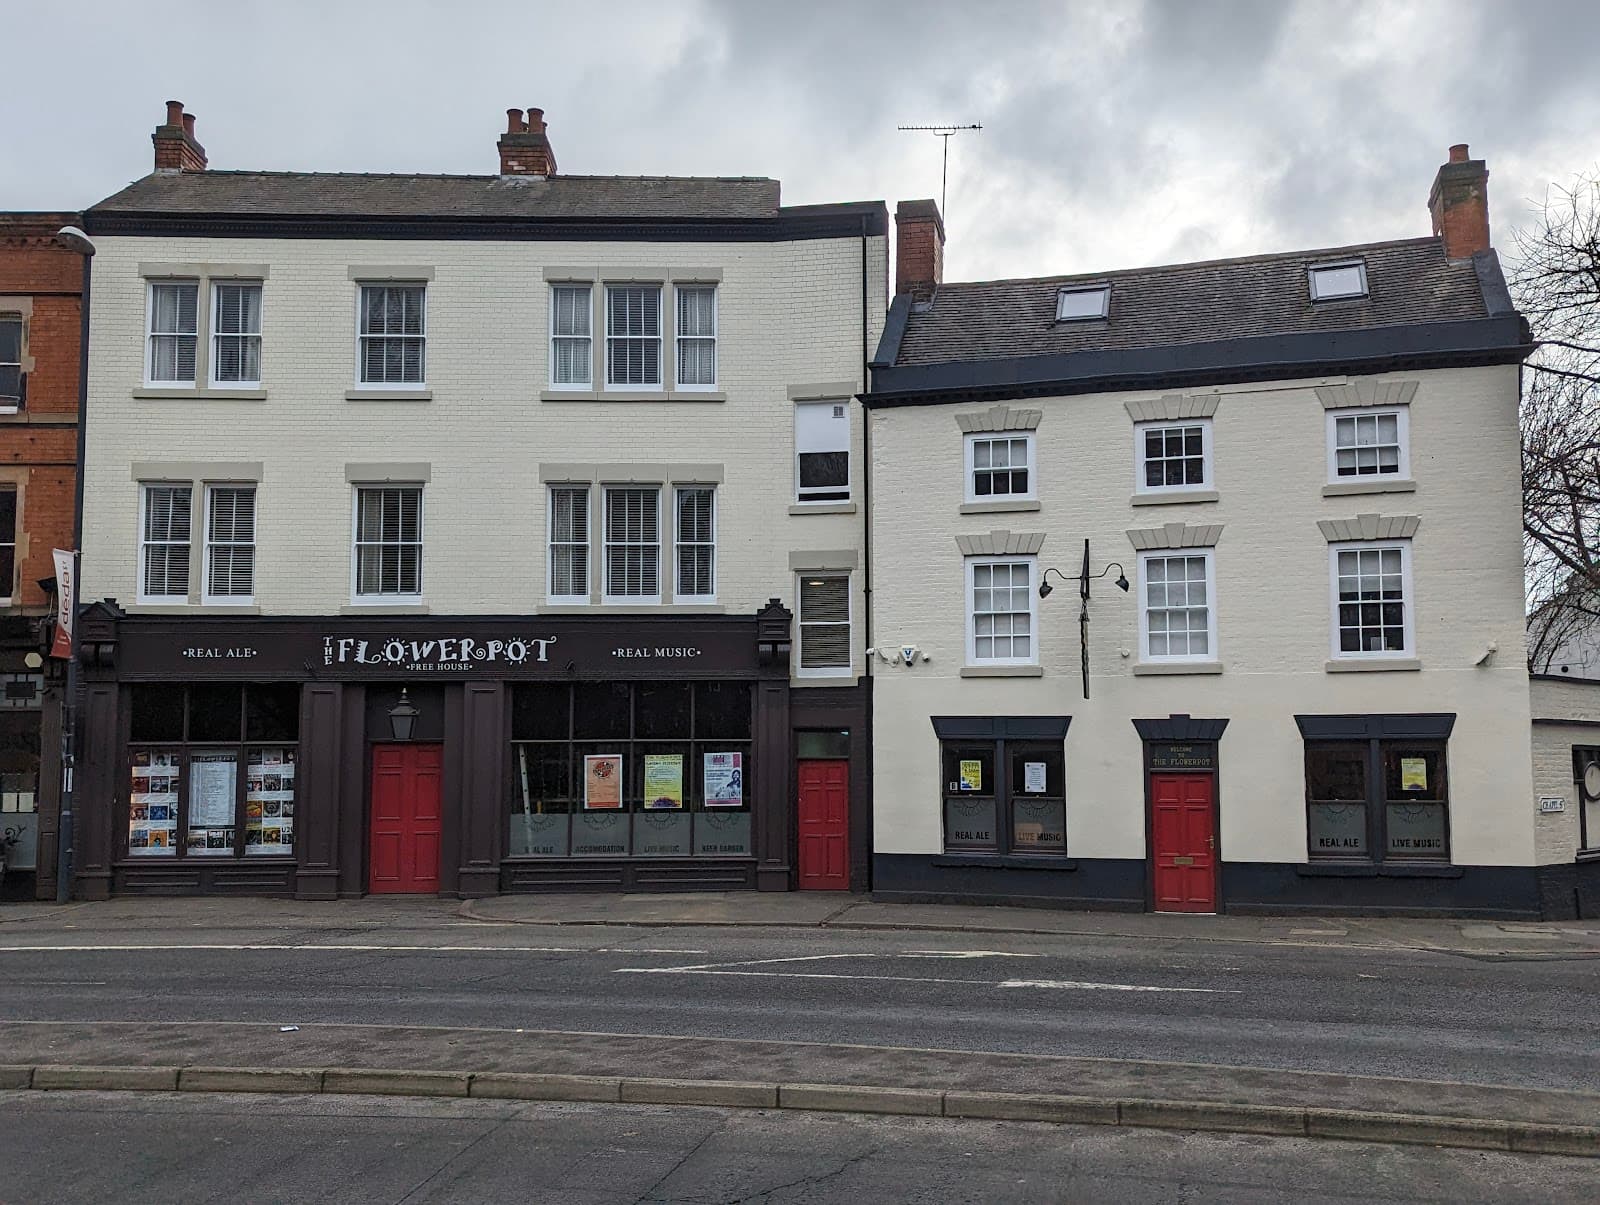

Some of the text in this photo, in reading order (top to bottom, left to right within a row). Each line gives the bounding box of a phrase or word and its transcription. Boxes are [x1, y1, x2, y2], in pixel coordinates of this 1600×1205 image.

[62, 571, 71, 625] deda
[188, 648, 252, 658] REAL ALE
[323, 636, 333, 665] THE
[337, 636, 557, 664] FLOWERPOT
[617, 648, 696, 658] REAL MUSIC
[410, 663, 469, 671] FREE HOUSE
[1152, 758, 1166, 766] THE
[955, 831, 990, 840] REAL ALE
[1018, 832, 1061, 841] LIVE MUSIC
[1320, 838, 1359, 848] REAL ALE
[1392, 838, 1440, 848] LIVE MUSIC
